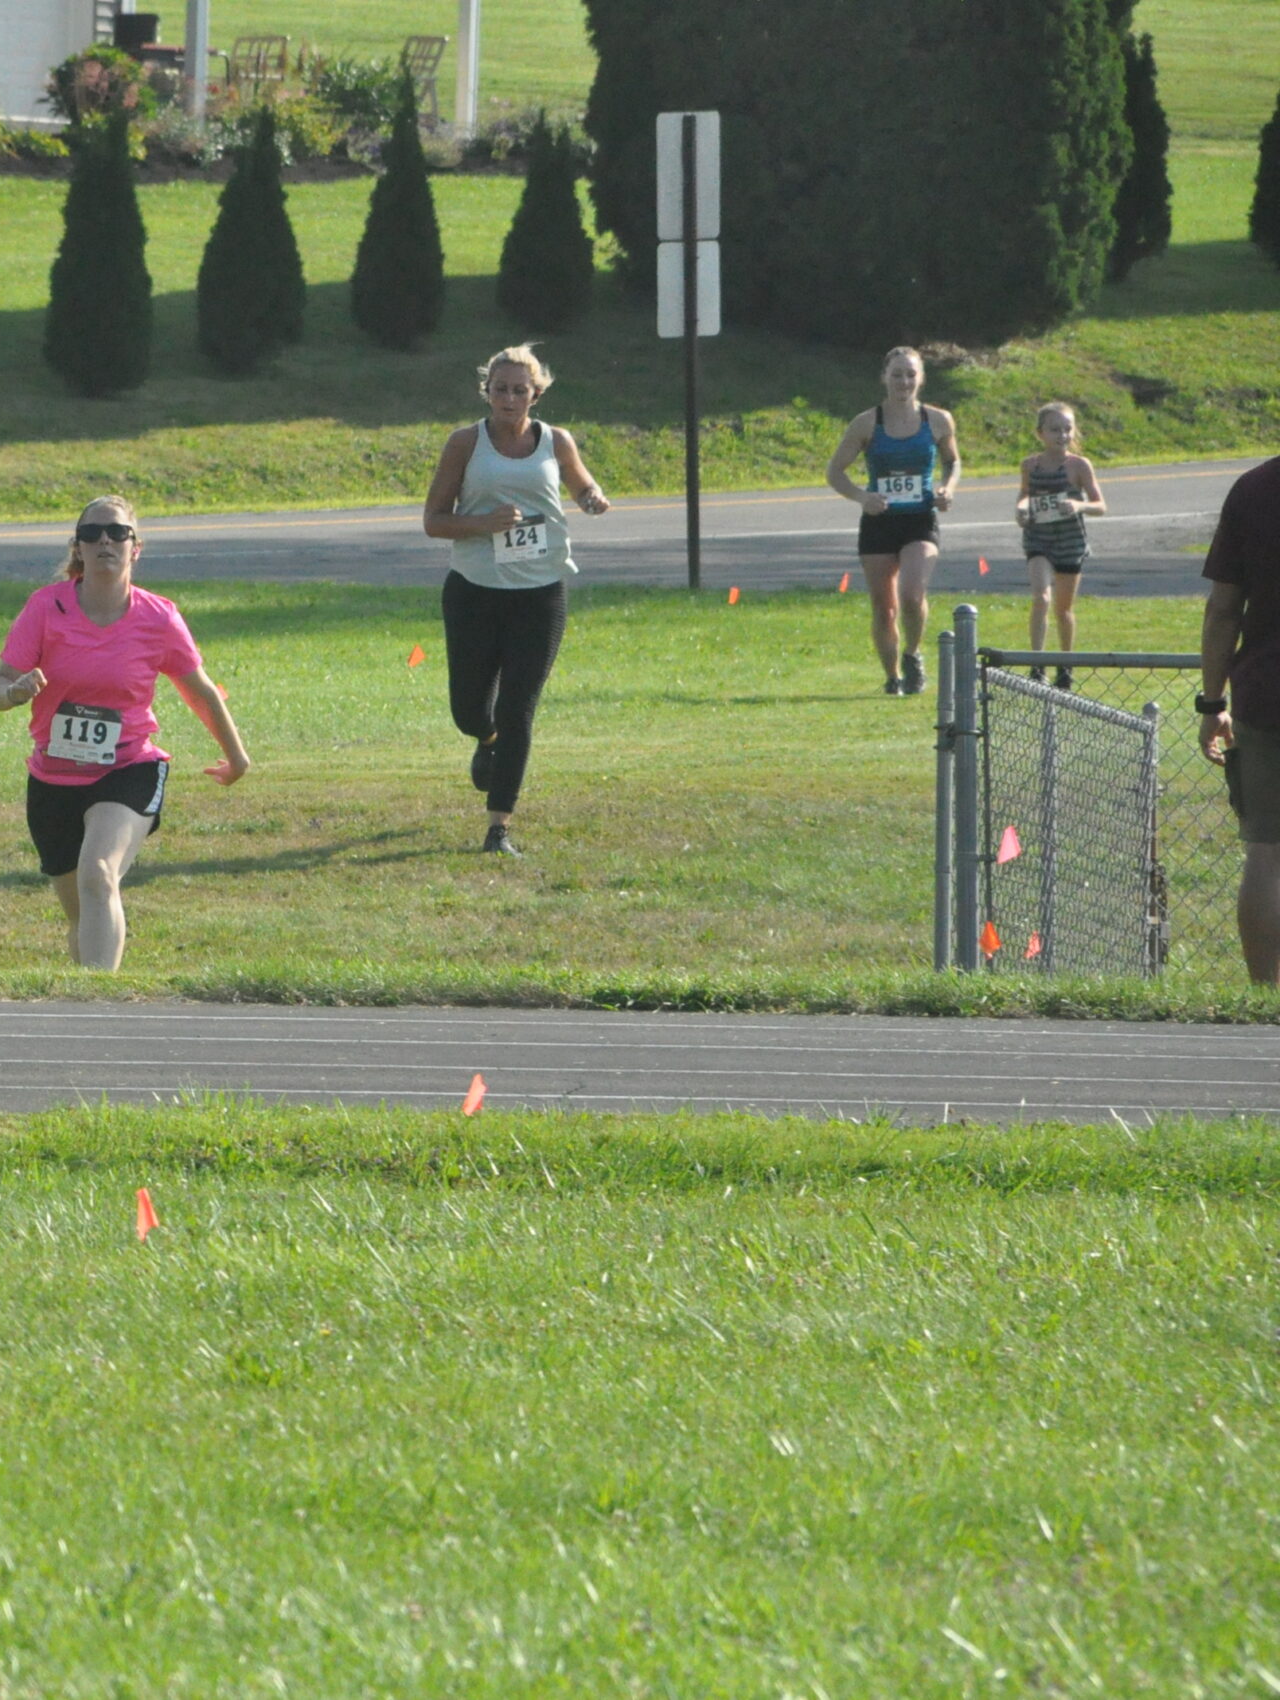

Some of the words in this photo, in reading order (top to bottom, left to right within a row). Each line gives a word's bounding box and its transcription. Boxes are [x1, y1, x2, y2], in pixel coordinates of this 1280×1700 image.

[885, 477, 914, 493] 166
[1033, 495, 1058, 512] 165
[504, 526, 539, 548] 124
[63, 717, 108, 745] 119
